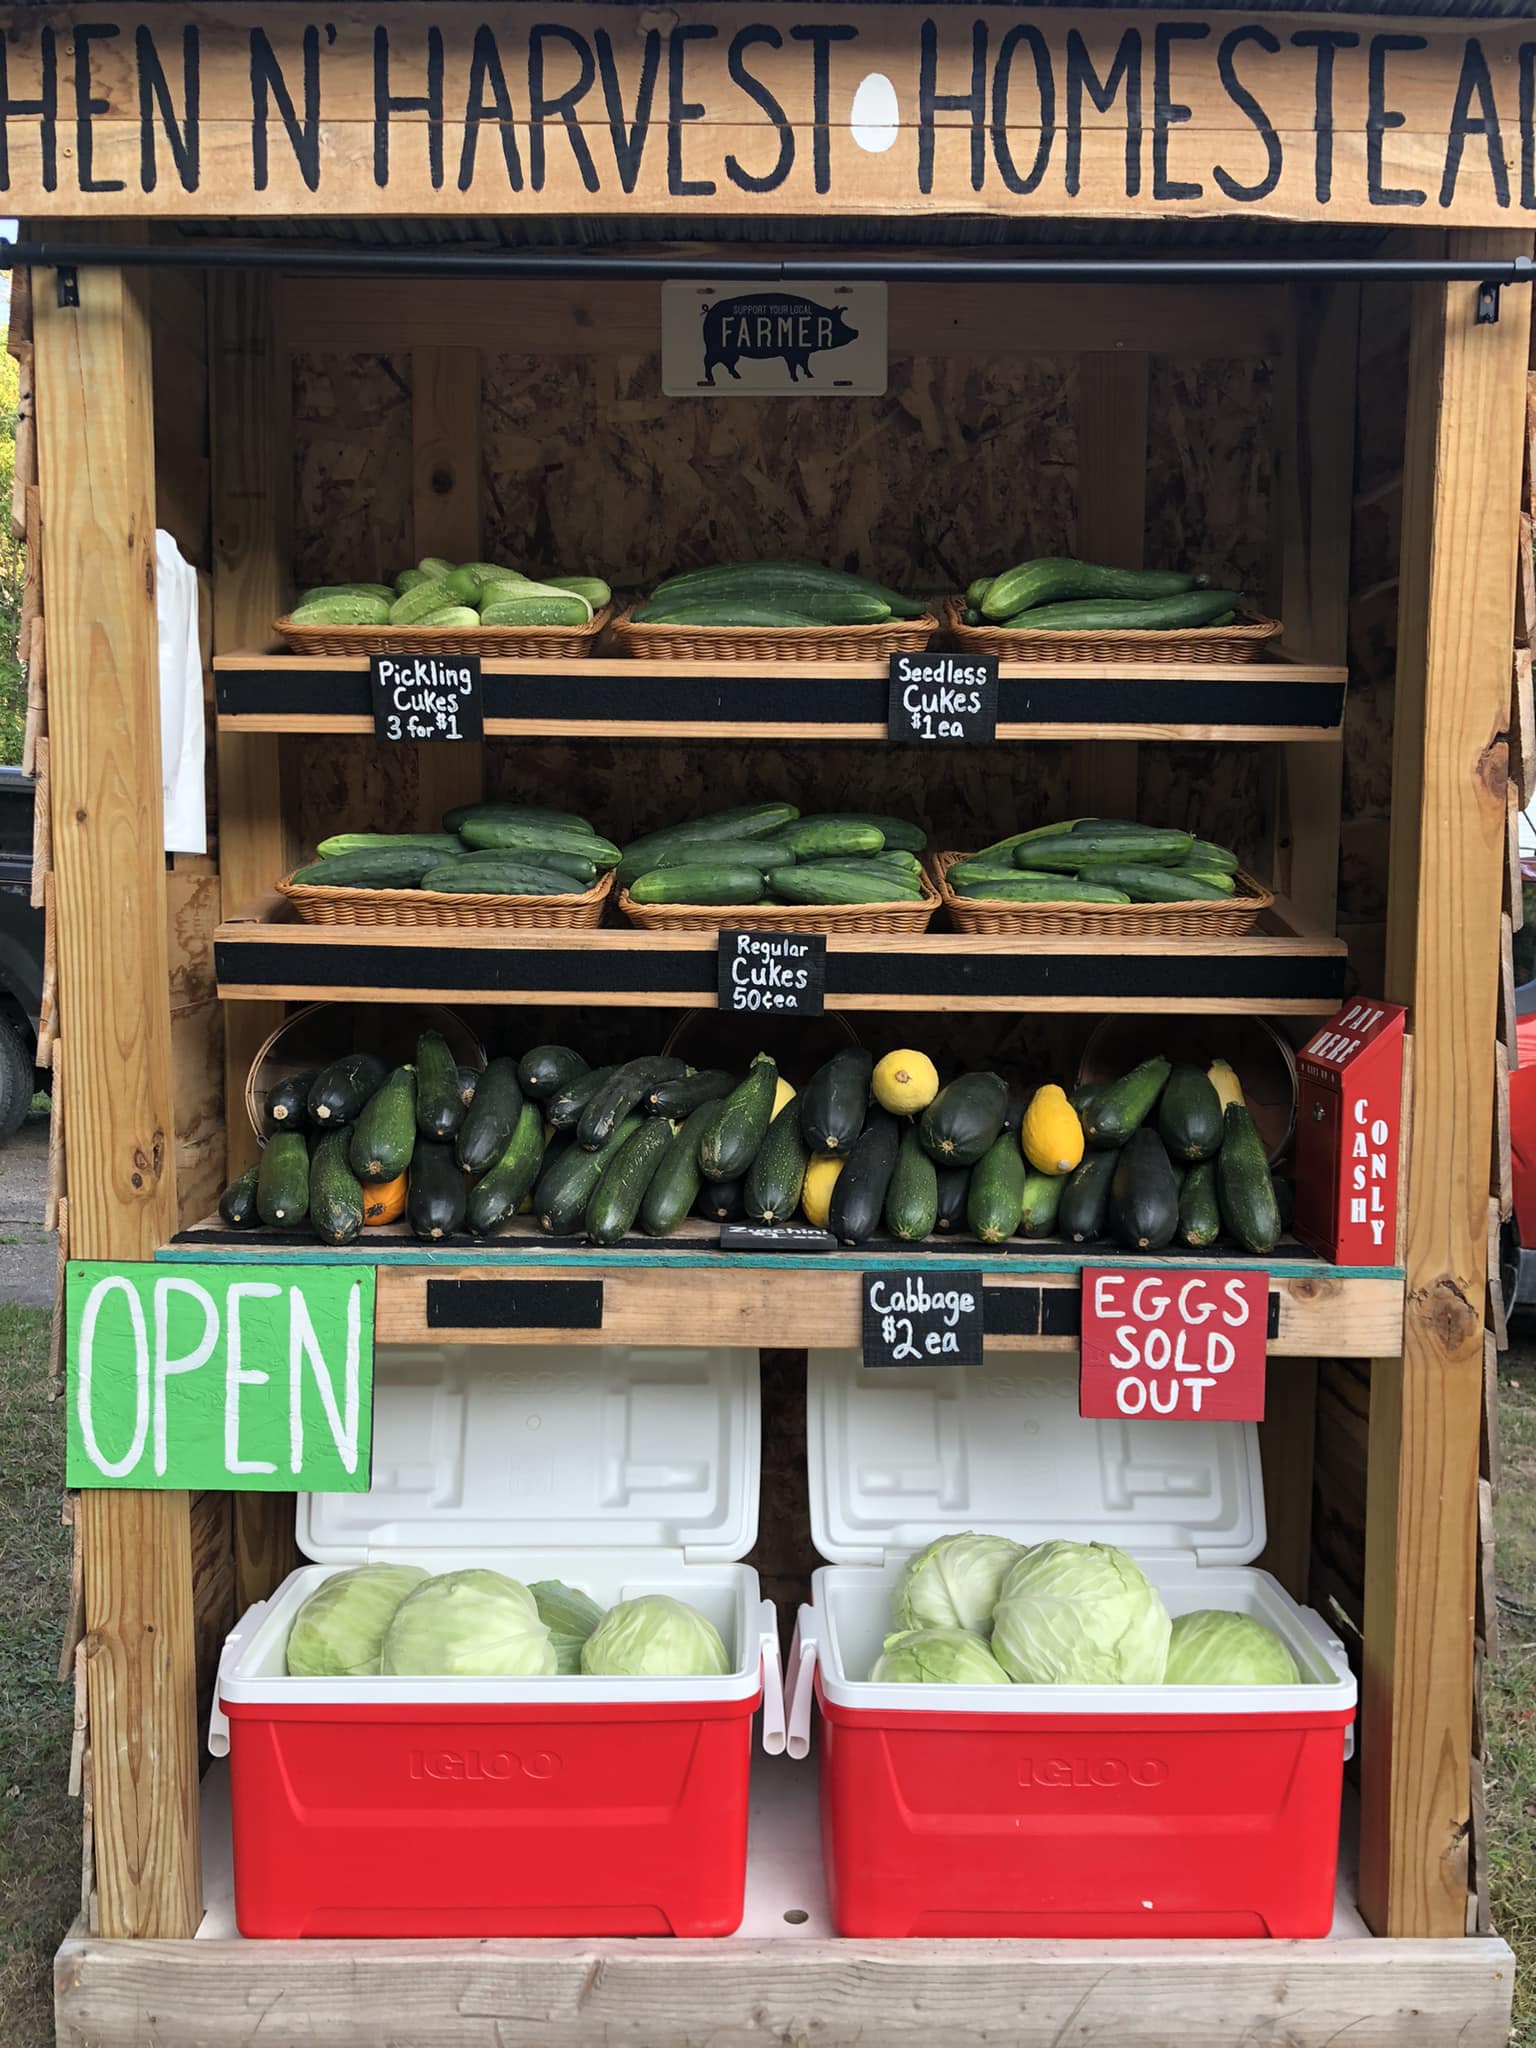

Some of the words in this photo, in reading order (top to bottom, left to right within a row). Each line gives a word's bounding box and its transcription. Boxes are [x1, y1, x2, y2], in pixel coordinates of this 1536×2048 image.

[0, 24, 200, 193] HEN
[373, 23, 858, 195] HARVEST
[733, 304, 767, 315] SUPPORT
[769, 304, 789, 315] YOUR
[790, 304, 813, 315] LOCAL
[722, 317, 833, 347] FARMER
[378, 659, 472, 695] Pickling
[898, 658, 987, 685] Seedless
[393, 686, 459, 713] Cukes
[903, 684, 981, 713] Cukes
[387, 715, 402, 740] 3
[407, 715, 435, 738] for
[737, 934, 808, 964] Regular
[732, 957, 808, 989] Cukes
[1338, 1004, 1385, 1033] PAY
[1307, 1031, 1361, 1064] HERE
[1351, 1099, 1369, 1223] CASH
[1370, 1119, 1388, 1245] ONLY
[870, 1276, 975, 1327] Cabbage
[1095, 1275, 1249, 1327] EGGS
[881, 1315, 923, 1360] $2
[925, 1331, 960, 1355] ea
[1109, 1325, 1236, 1374] SOLD
[77, 1275, 361, 1478] OPEN
[1116, 1376, 1217, 1414] OUT
[409, 1749, 568, 1781] IGLOO
[1017, 1757, 1170, 1788] IGLOO
